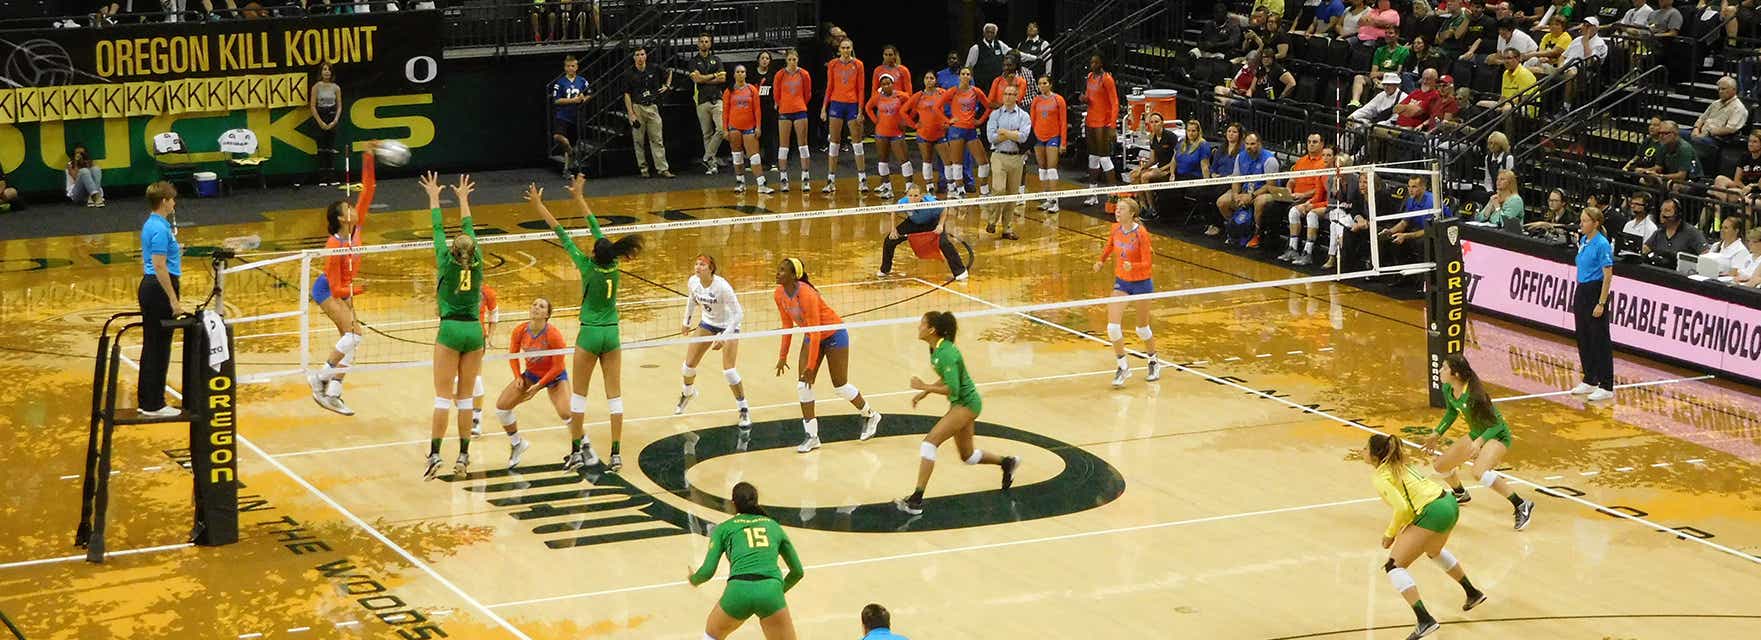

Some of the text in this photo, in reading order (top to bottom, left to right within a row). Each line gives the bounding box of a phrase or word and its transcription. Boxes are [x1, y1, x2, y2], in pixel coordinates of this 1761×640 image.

[96, 25, 378, 78] OREGON KILL KOUNT
[405, 55, 438, 83] O
[0, 93, 435, 174] UCKS
[1447, 260, 1463, 353] OREGON
[1509, 266, 1577, 313] OFFICIAL
[1608, 290, 1669, 337] ARABLE
[209, 376, 233, 483] OREGON
[257, 515, 334, 556] THE
[743, 527, 770, 549] 15
